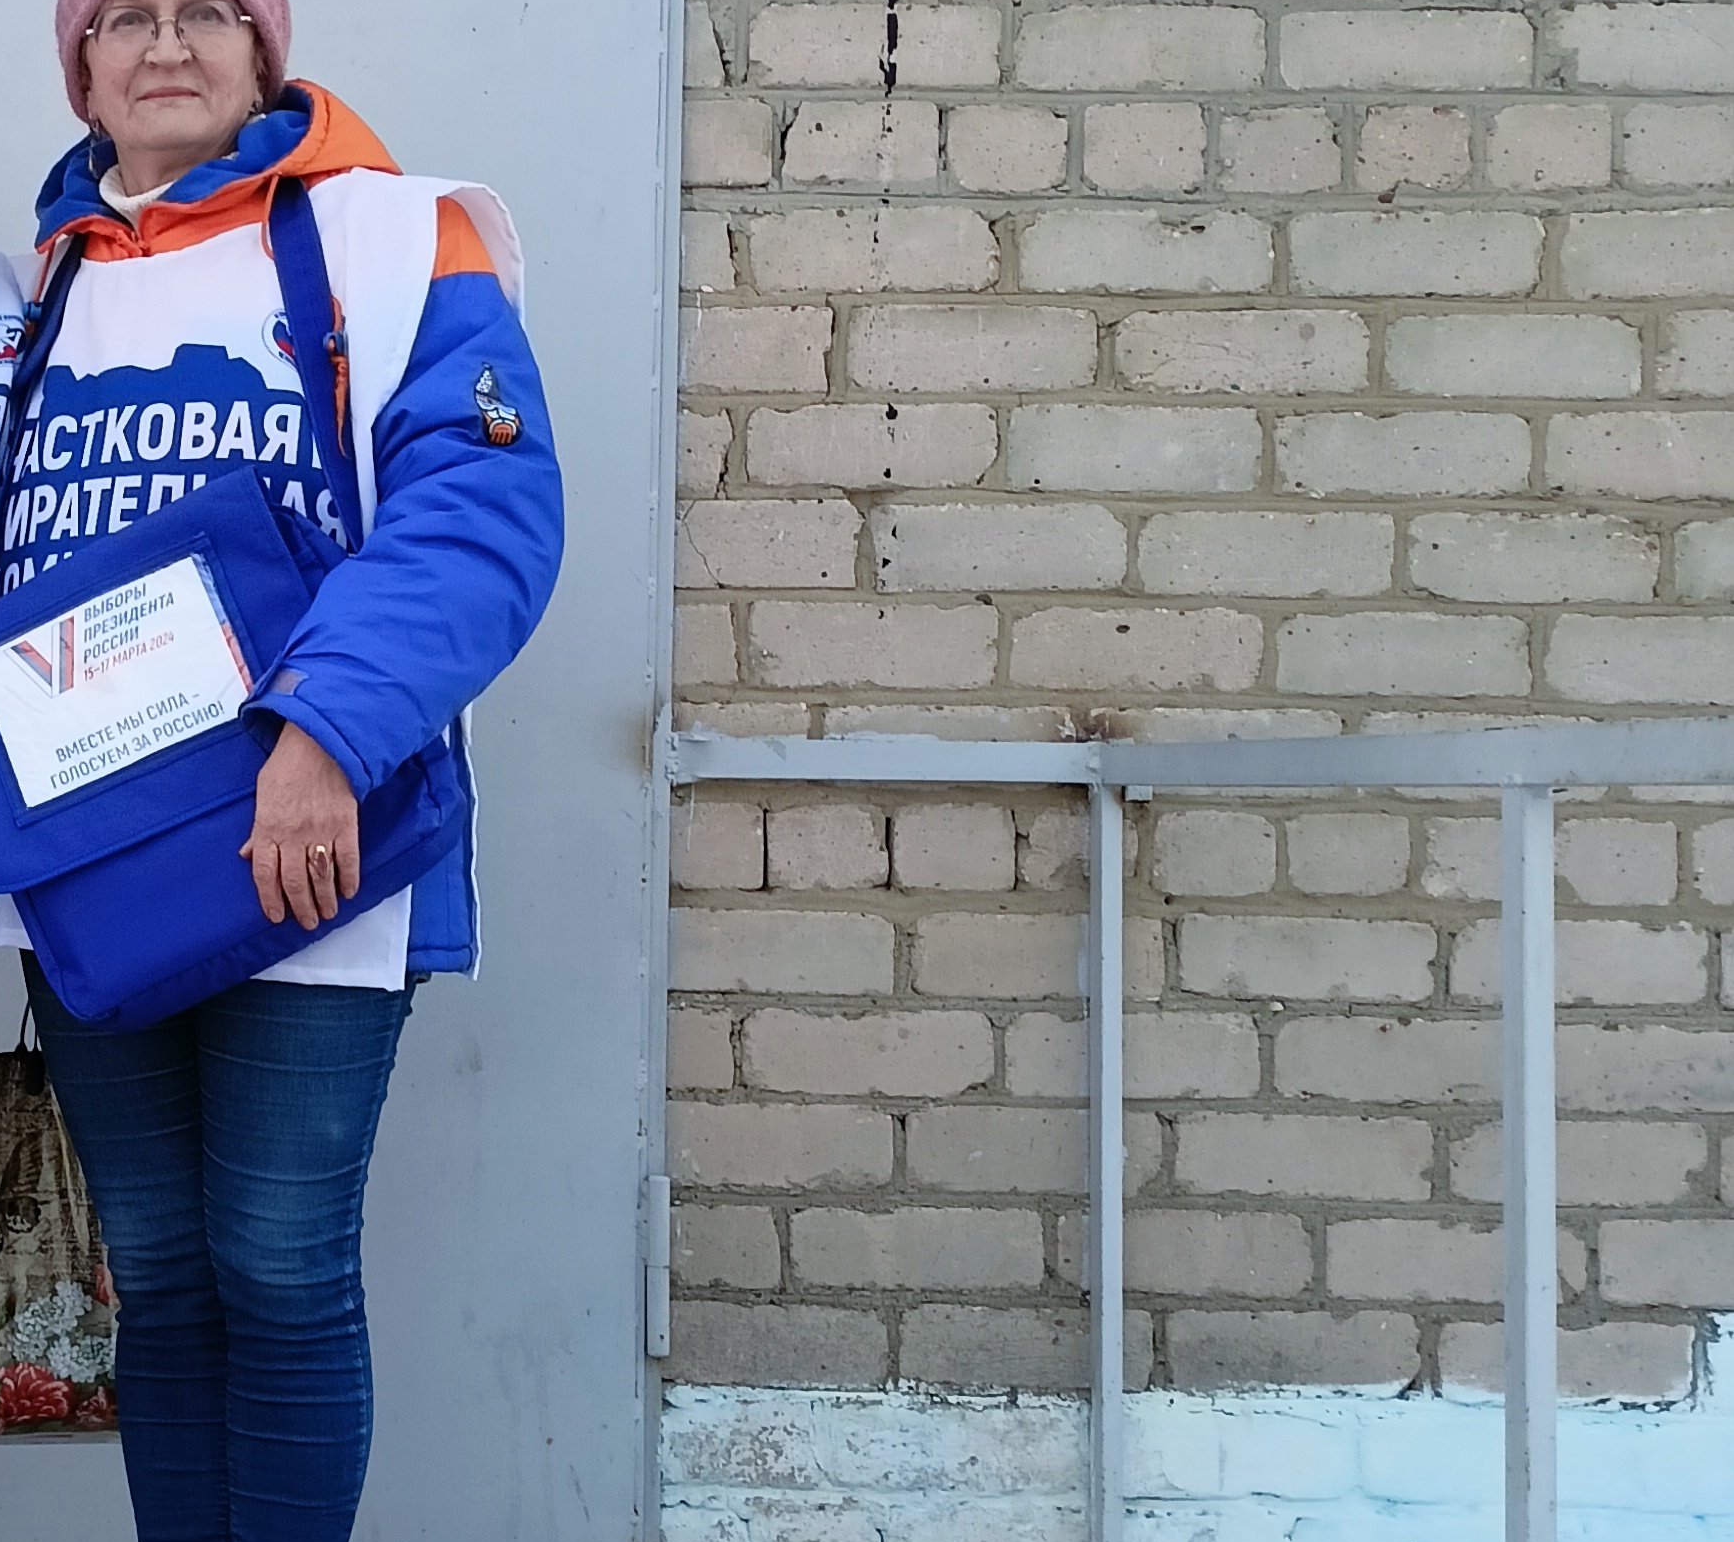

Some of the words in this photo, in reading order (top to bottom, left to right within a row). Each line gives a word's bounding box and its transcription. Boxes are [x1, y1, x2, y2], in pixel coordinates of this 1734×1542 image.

[13, 400, 301, 483] АСТКОВАЯ
[83, 582, 147, 623] ВЫБОРЫ
[83, 591, 175, 643] ПРЕЗИДЕНТА
[83, 626, 140, 664] РОССИИ
[112, 643, 148, 671] МАРТА
[149, 630, 175, 652] 2024
[50, 743, 130, 790] ГОЛОСУЕМ
[131, 733, 152, 753] ЗА
[154, 700, 225, 742] РОССИЮ!
[55, 724, 115, 763] ВМЕСТЕ
[116, 711, 144, 737] МЫ
[146, 691, 189, 720] СИЛА
